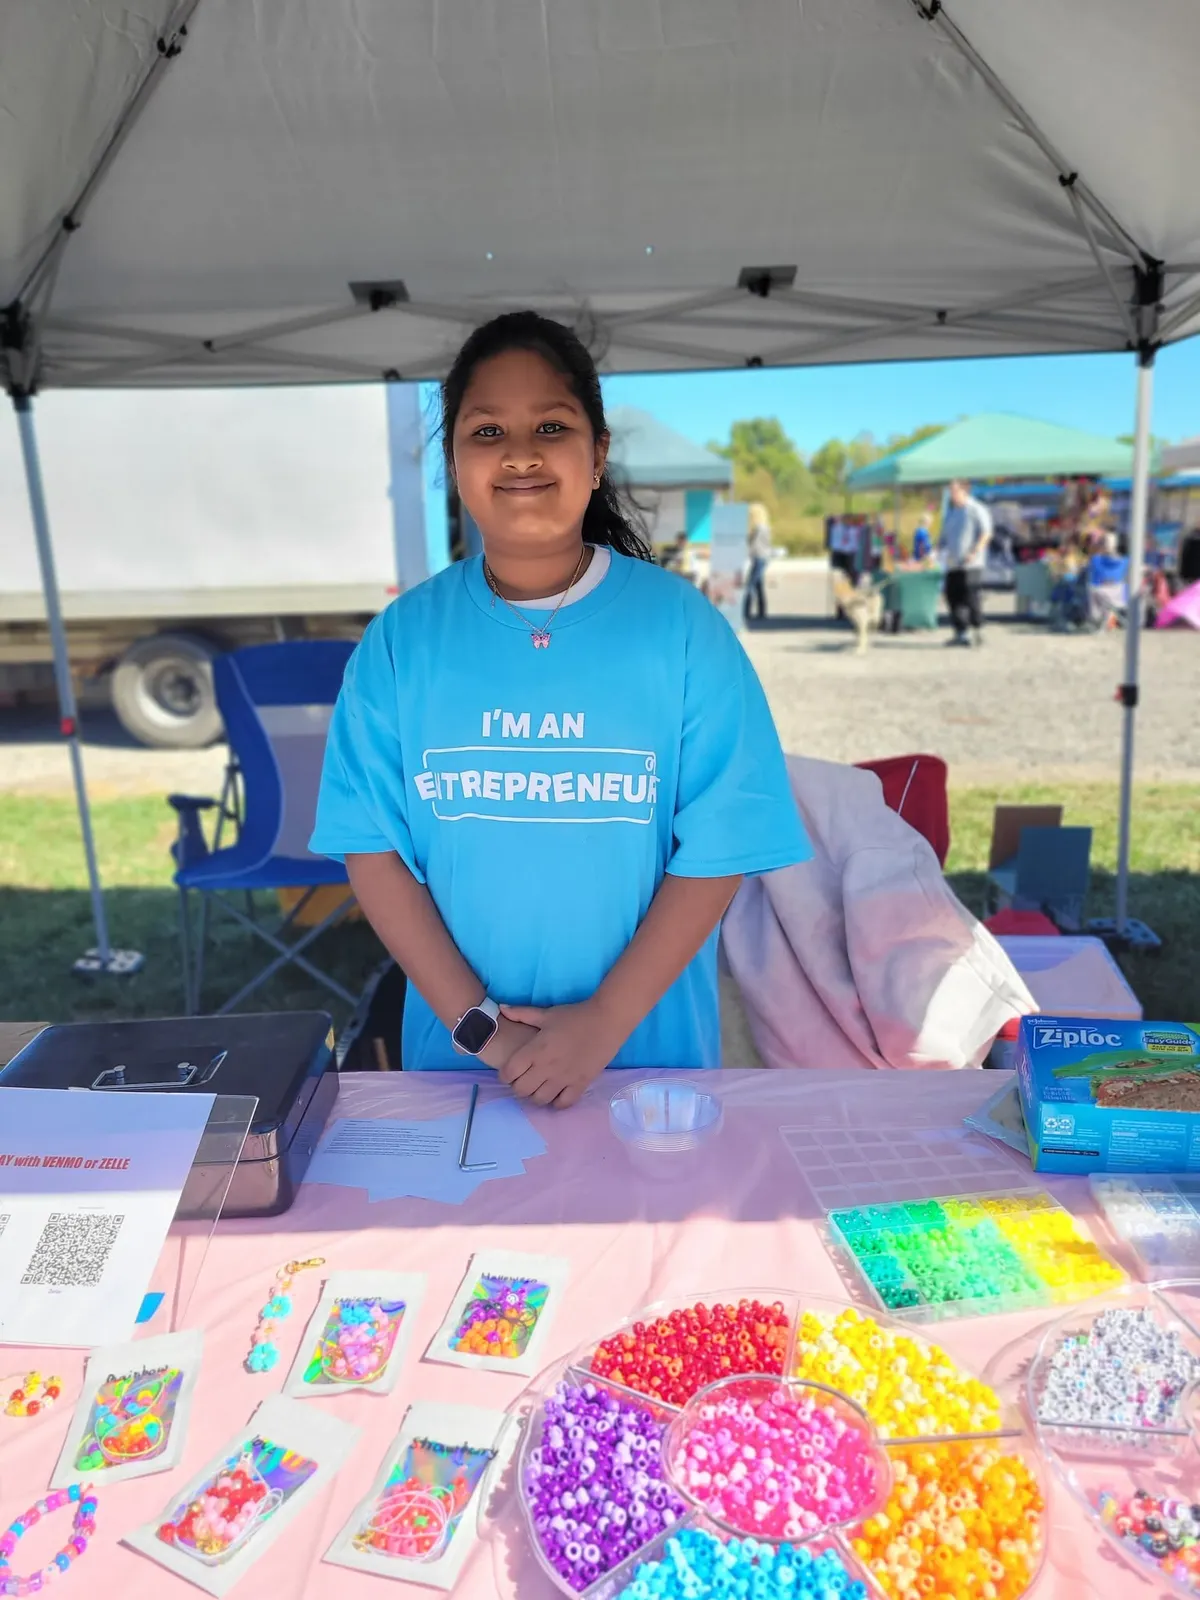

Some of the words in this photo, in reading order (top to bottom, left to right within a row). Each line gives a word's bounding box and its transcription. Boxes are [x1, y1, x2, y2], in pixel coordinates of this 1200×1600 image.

[482, 708, 531, 738] I'M
[537, 712, 585, 739] AN
[1039, 1029, 1122, 1048] Ziploc
[14, 1155, 40, 1167] with
[42, 1156, 84, 1169] VENMO
[84, 1159, 98, 1169] or
[98, 1158, 131, 1170] ZELLE
